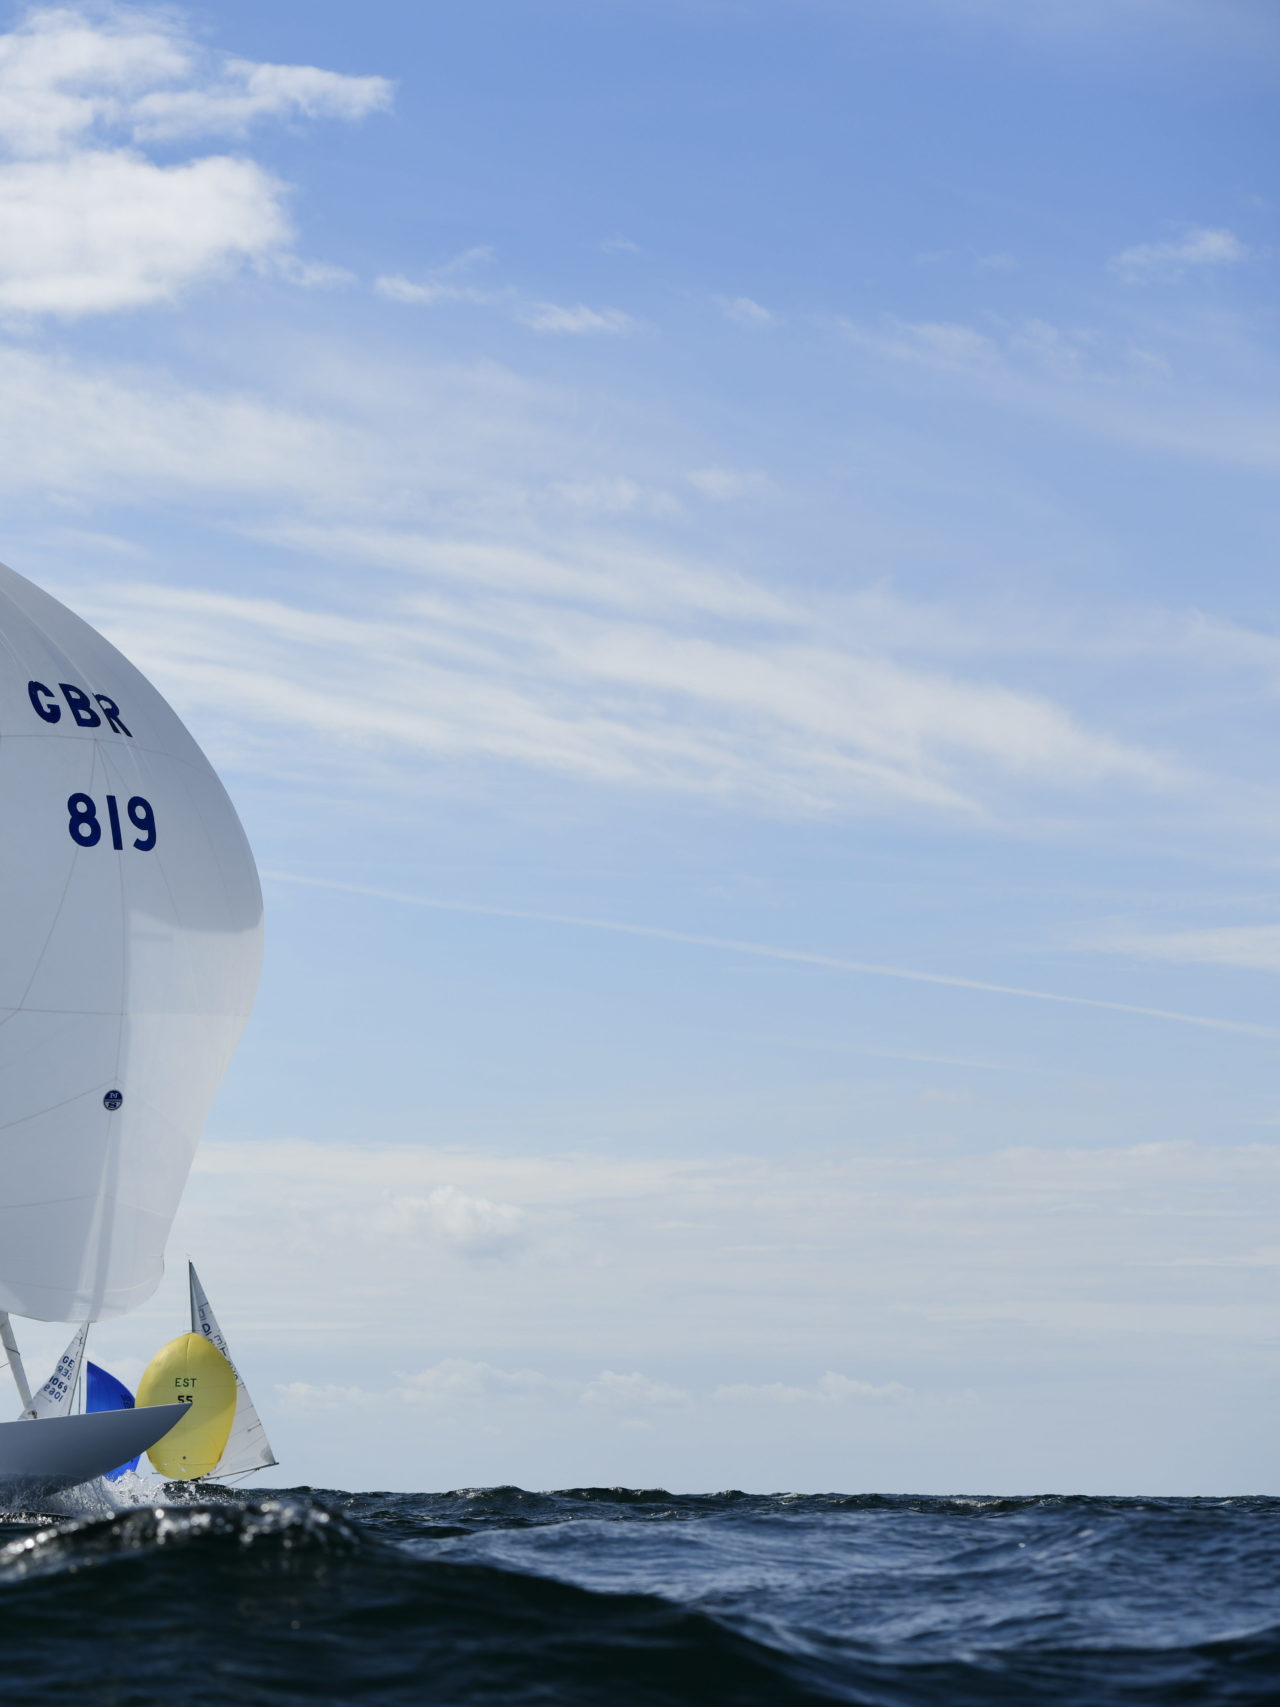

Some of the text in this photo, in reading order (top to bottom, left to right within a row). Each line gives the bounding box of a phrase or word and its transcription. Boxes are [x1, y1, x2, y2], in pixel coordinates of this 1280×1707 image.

[28, 680, 133, 738] GBR
[67, 792, 157, 852] 819
[62, 1355, 76, 1369] GE
[175, 1377, 197, 1388] EST
[177, 1394, 193, 1403] 55
